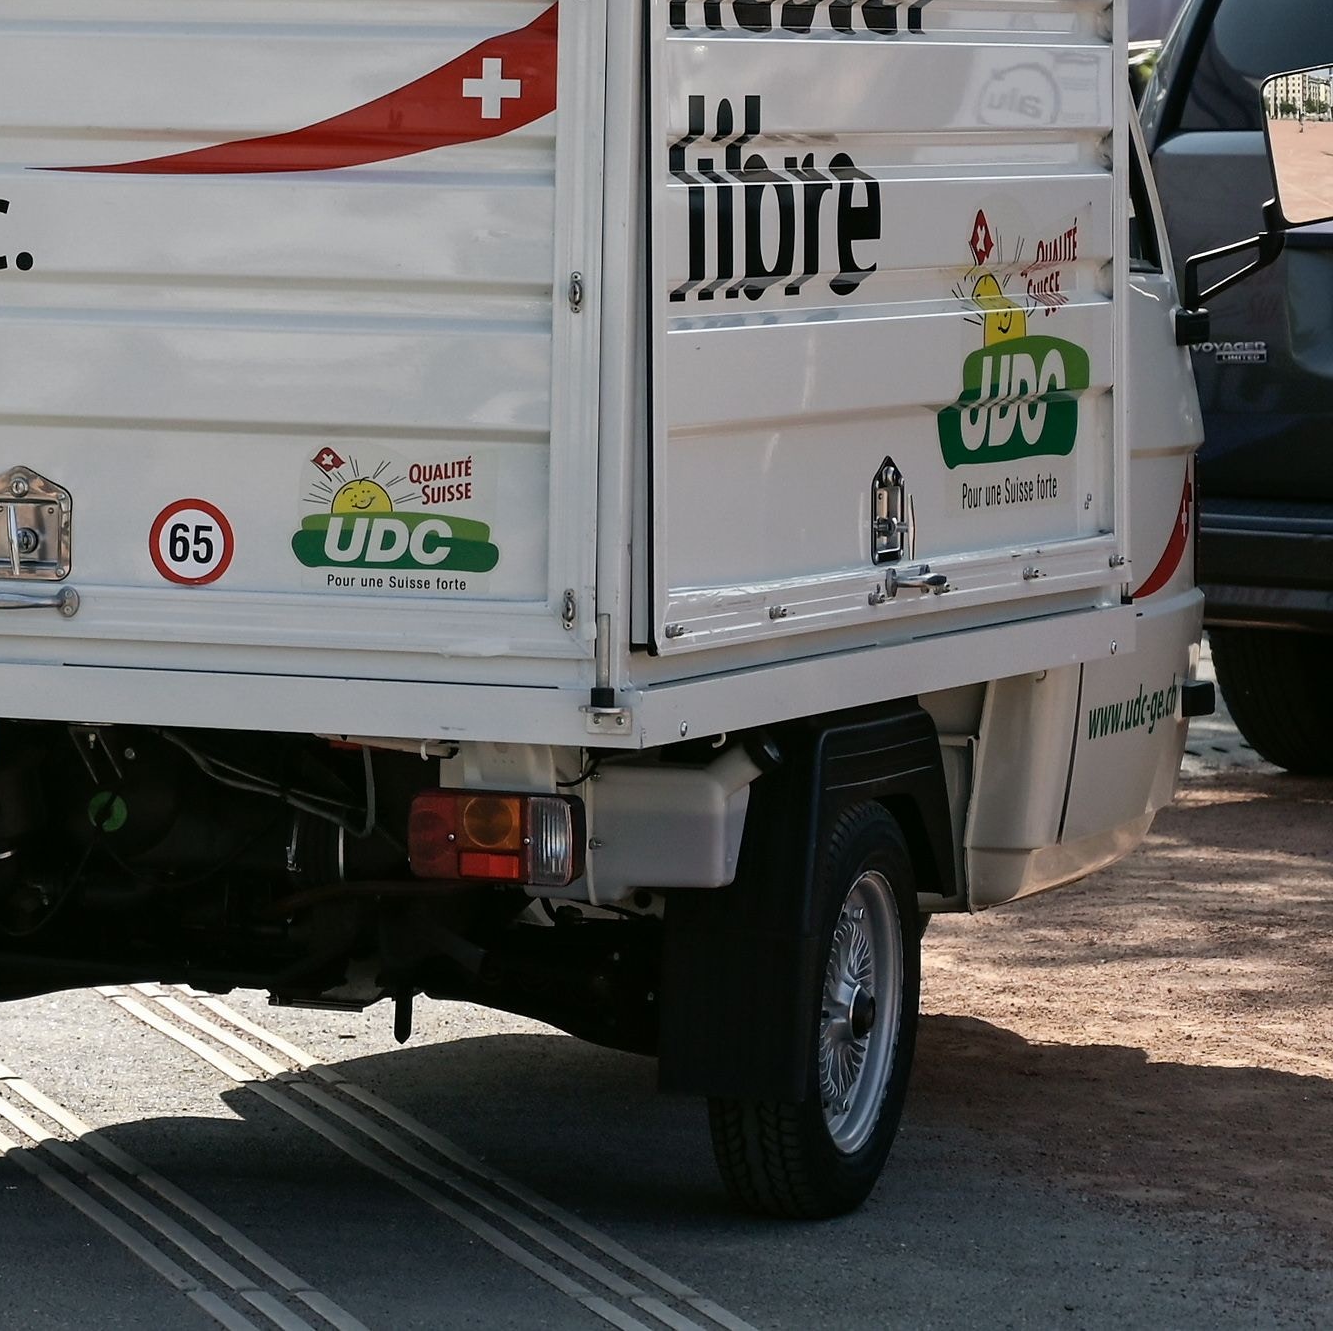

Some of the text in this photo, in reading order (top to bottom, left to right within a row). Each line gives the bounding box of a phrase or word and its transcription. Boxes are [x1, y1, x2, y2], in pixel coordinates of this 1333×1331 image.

[669, 94, 882, 304] libre
[1191, 341, 1266, 352] VOYAGER
[960, 348, 1067, 451] UDC
[409, 456, 472, 484] QUALITÉ
[421, 482, 472, 505] SUISSE
[962, 473, 1057, 509] Pour une Suisse forte
[169, 523, 213, 564] 65
[324, 517, 453, 565] UDC
[327, 574, 467, 590] Pour une Suisse forte
[1088, 673, 1177, 740] www.udc-ge.ch
